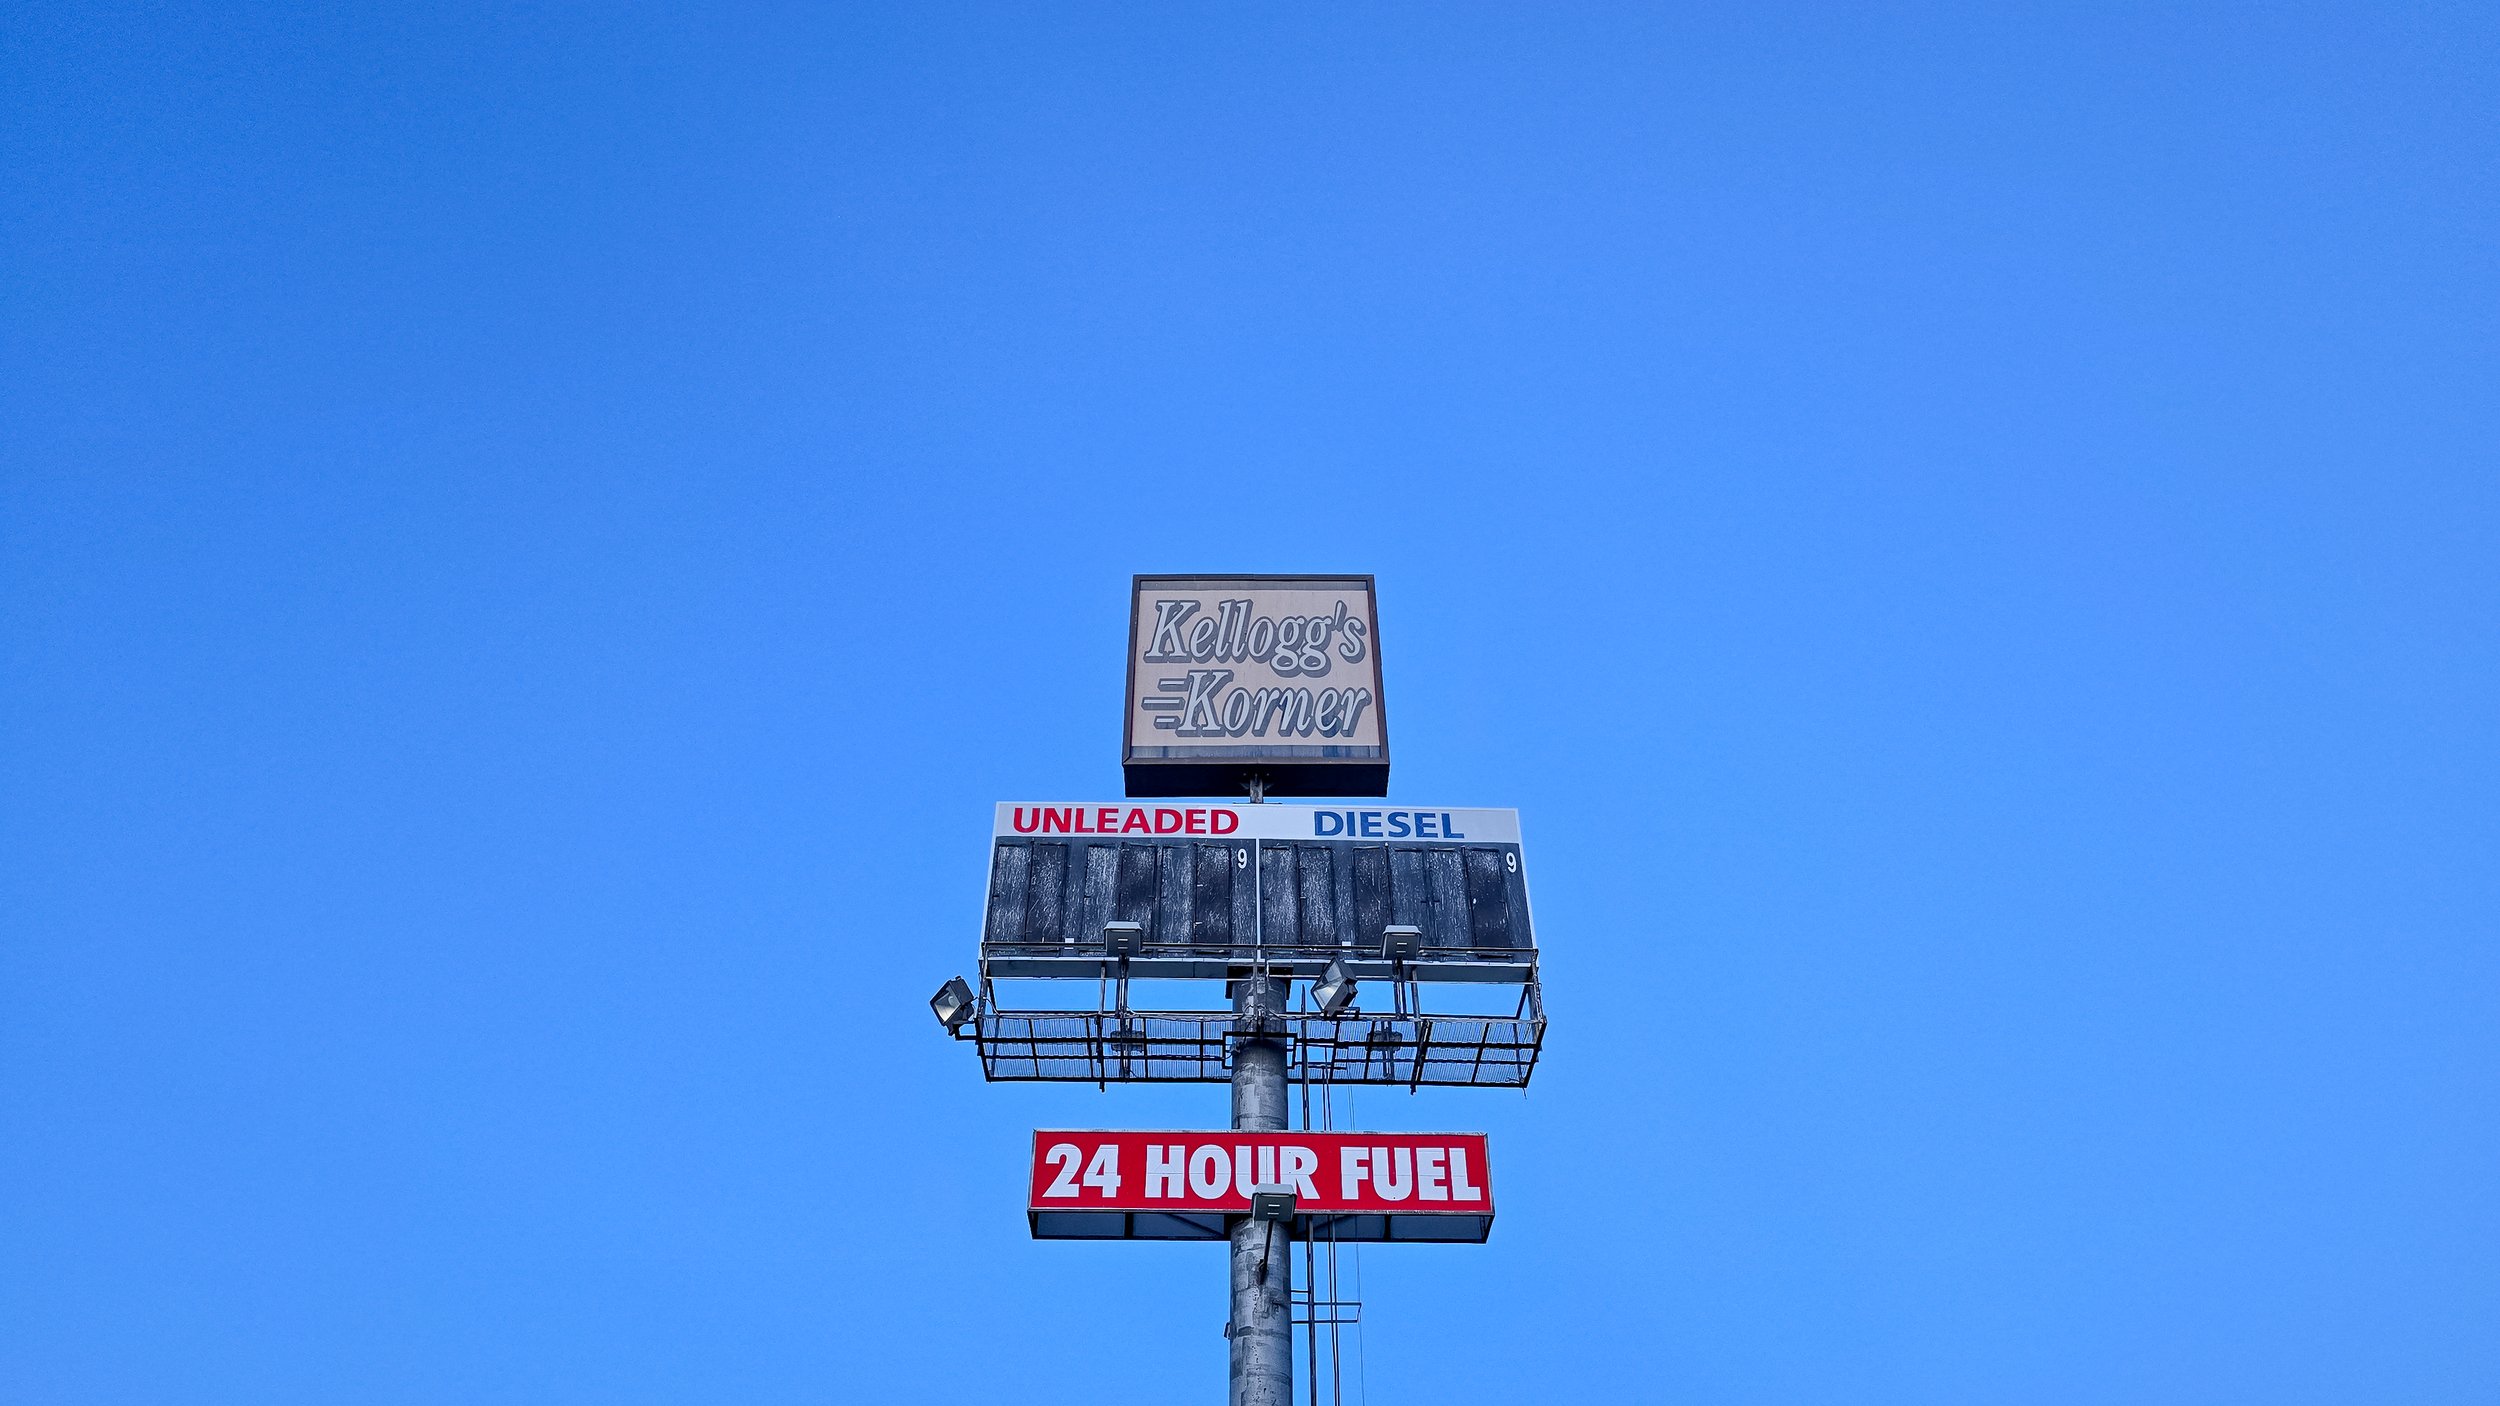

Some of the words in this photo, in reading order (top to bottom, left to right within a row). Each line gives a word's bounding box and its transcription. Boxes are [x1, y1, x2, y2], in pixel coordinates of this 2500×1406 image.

[1143, 599, 1366, 677] Kellogg's
[1175, 669, 1372, 737] Korner
[1013, 807, 1239, 834] UNLEADED
[1313, 811, 1465, 839] DIESEL
[1237, 848, 1247, 869] 9
[1505, 852, 1517, 873] 9
[1042, 1143, 1121, 1198] 24
[1144, 1144, 1320, 1200] HOUR
[1340, 1146, 1481, 1200] FUEL
